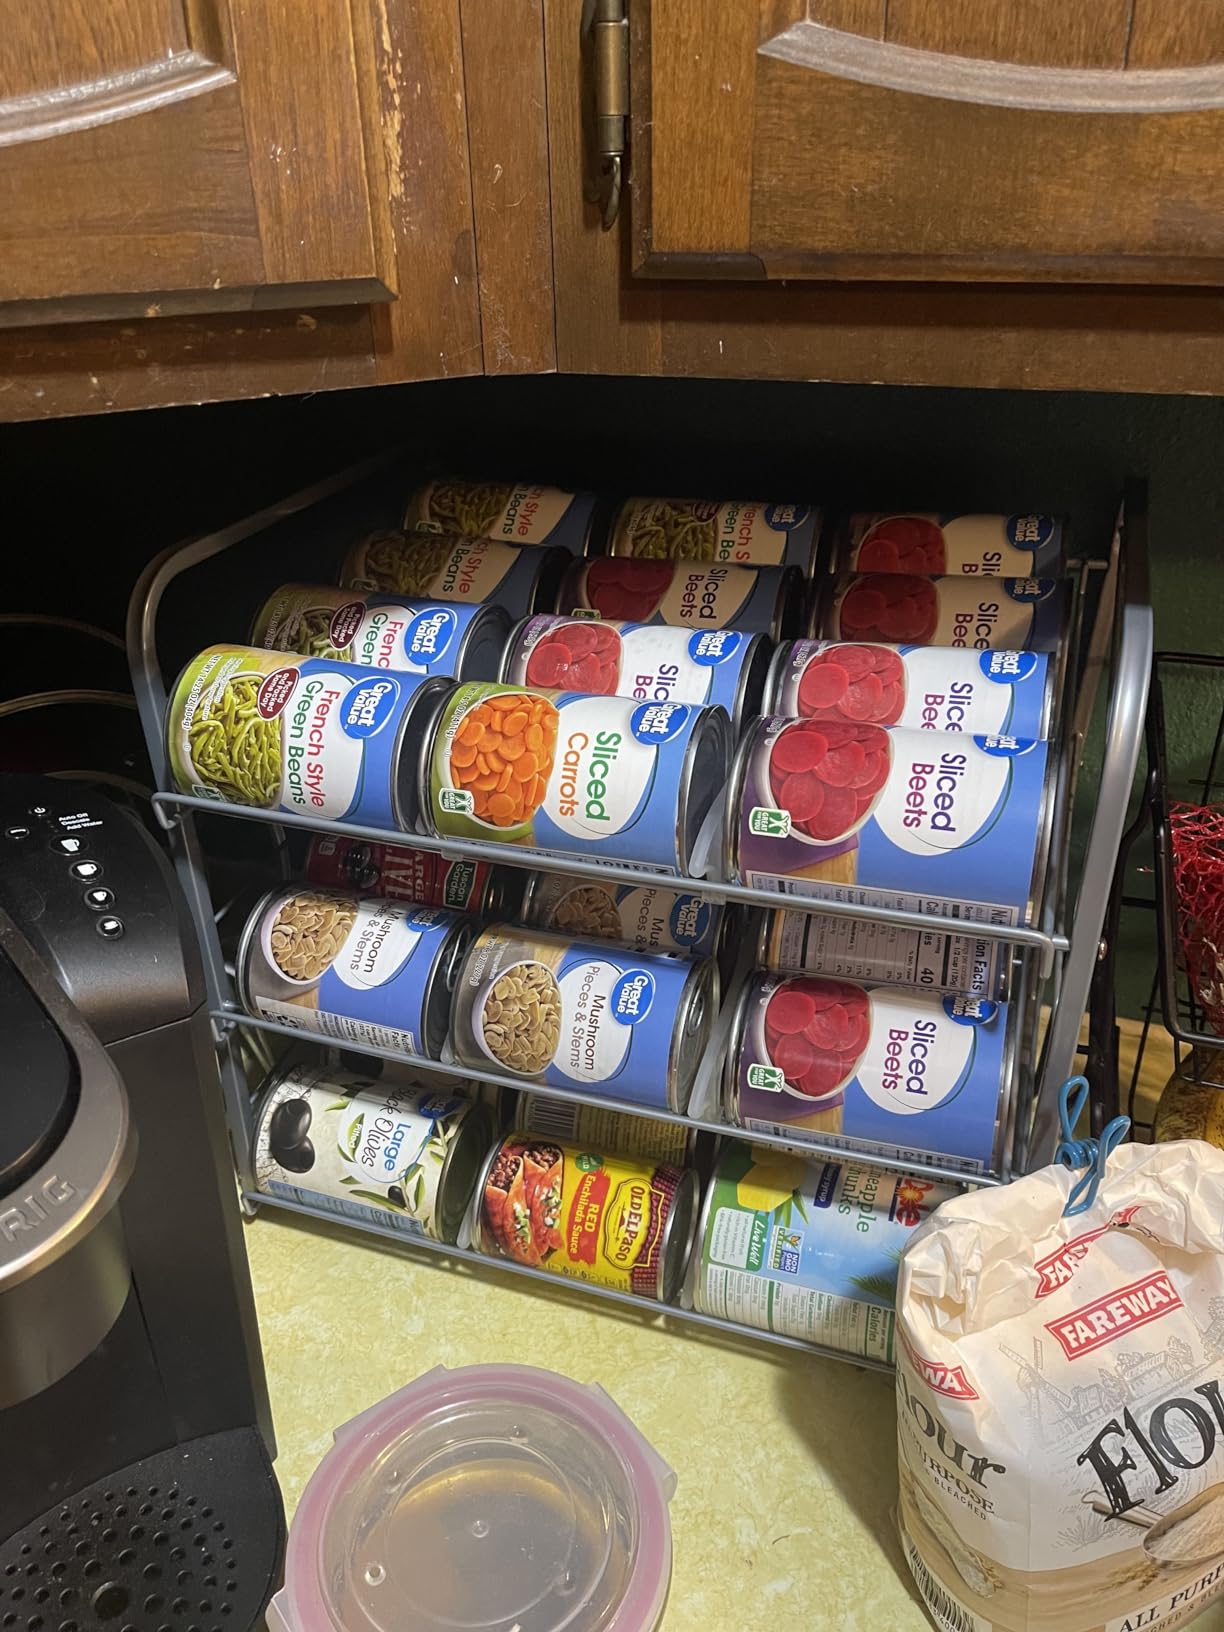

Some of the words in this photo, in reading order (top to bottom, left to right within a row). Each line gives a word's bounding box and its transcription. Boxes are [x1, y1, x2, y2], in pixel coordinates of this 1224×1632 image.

[502, 493, 527, 536] Beans
[517, 499, 539, 537] Style
[442, 546, 464, 594] Beans
[458, 552, 484, 596] Style
[679, 573, 706, 618] Beets
[698, 568, 729, 620] Sliced
[410, 616, 433, 654] Value
[420, 611, 451, 655] Great
[695, 631, 717, 657] Value
[707, 630, 733, 658] Great
[260, 691, 273, 709] Day
[266, 684, 282, 713] Packed
[267, 673, 283, 692] Same
[277, 680, 294, 705] Picked
[357, 679, 394, 728] Great
[290, 679, 325, 740] Green
[306, 688, 341, 759] French
[346, 684, 375, 726] Value
[637, 703, 660, 735] Value
[649, 702, 677, 736] Great
[286, 743, 307, 806] Beans
[304, 760, 327, 808] Style
[558, 731, 590, 818] Carrots
[585, 730, 623, 822] Sliced
[929, 752, 968, 834] Sliced
[902, 762, 936, 830] Beets
[754, 819, 762, 831] YOU
[760, 811, 769, 832] GREAT
[448, 863, 465, 901] Garden
[456, 866, 474, 902] Tuscan
[636, 887, 658, 933] Pieces
[674, 903, 691, 936] Value
[685, 896, 706, 938] Great
[349, 929, 370, 971] Stems
[363, 911, 405, 974] Mushroom
[577, 965, 600, 1009] Pieces
[616, 978, 636, 1014] Value
[624, 974, 650, 1016] Great
[920, 967, 935, 985] 40
[971, 960, 988, 991] Facts
[573, 1012, 584, 1024] &
[584, 994, 607, 1071] Mushroom
[569, 1026, 587, 1069] Stems
[881, 1028, 910, 1091] Beets
[905, 1019, 938, 1096] Sliced
[758, 1068, 766, 1086] GREAT
[361, 1117, 394, 1168] Olives
[383, 1122, 412, 1172] Large
[573, 1174, 596, 1224] Enchilada
[582, 1202, 601, 1233] RED
[628, 1184, 647, 1211] OLD
[894, 1177, 936, 1229] Dole
[569, 1222, 584, 1254] Sauce
[624, 1209, 644, 1229] EL
[752, 1219, 766, 1242] Live
[748, 1240, 761, 1267] Well
[772, 1229, 785, 1269] VERIFIED
[784, 1252, 793, 1272] GMO
[789, 1253, 800, 1274] NON
[868, 1306, 882, 1343] Calories
[1059, 1278, 1178, 1349] FAREWAY
[933, 1476, 988, 1522] BLEACHED
[1119, 1604, 1162, 1632] ALL
